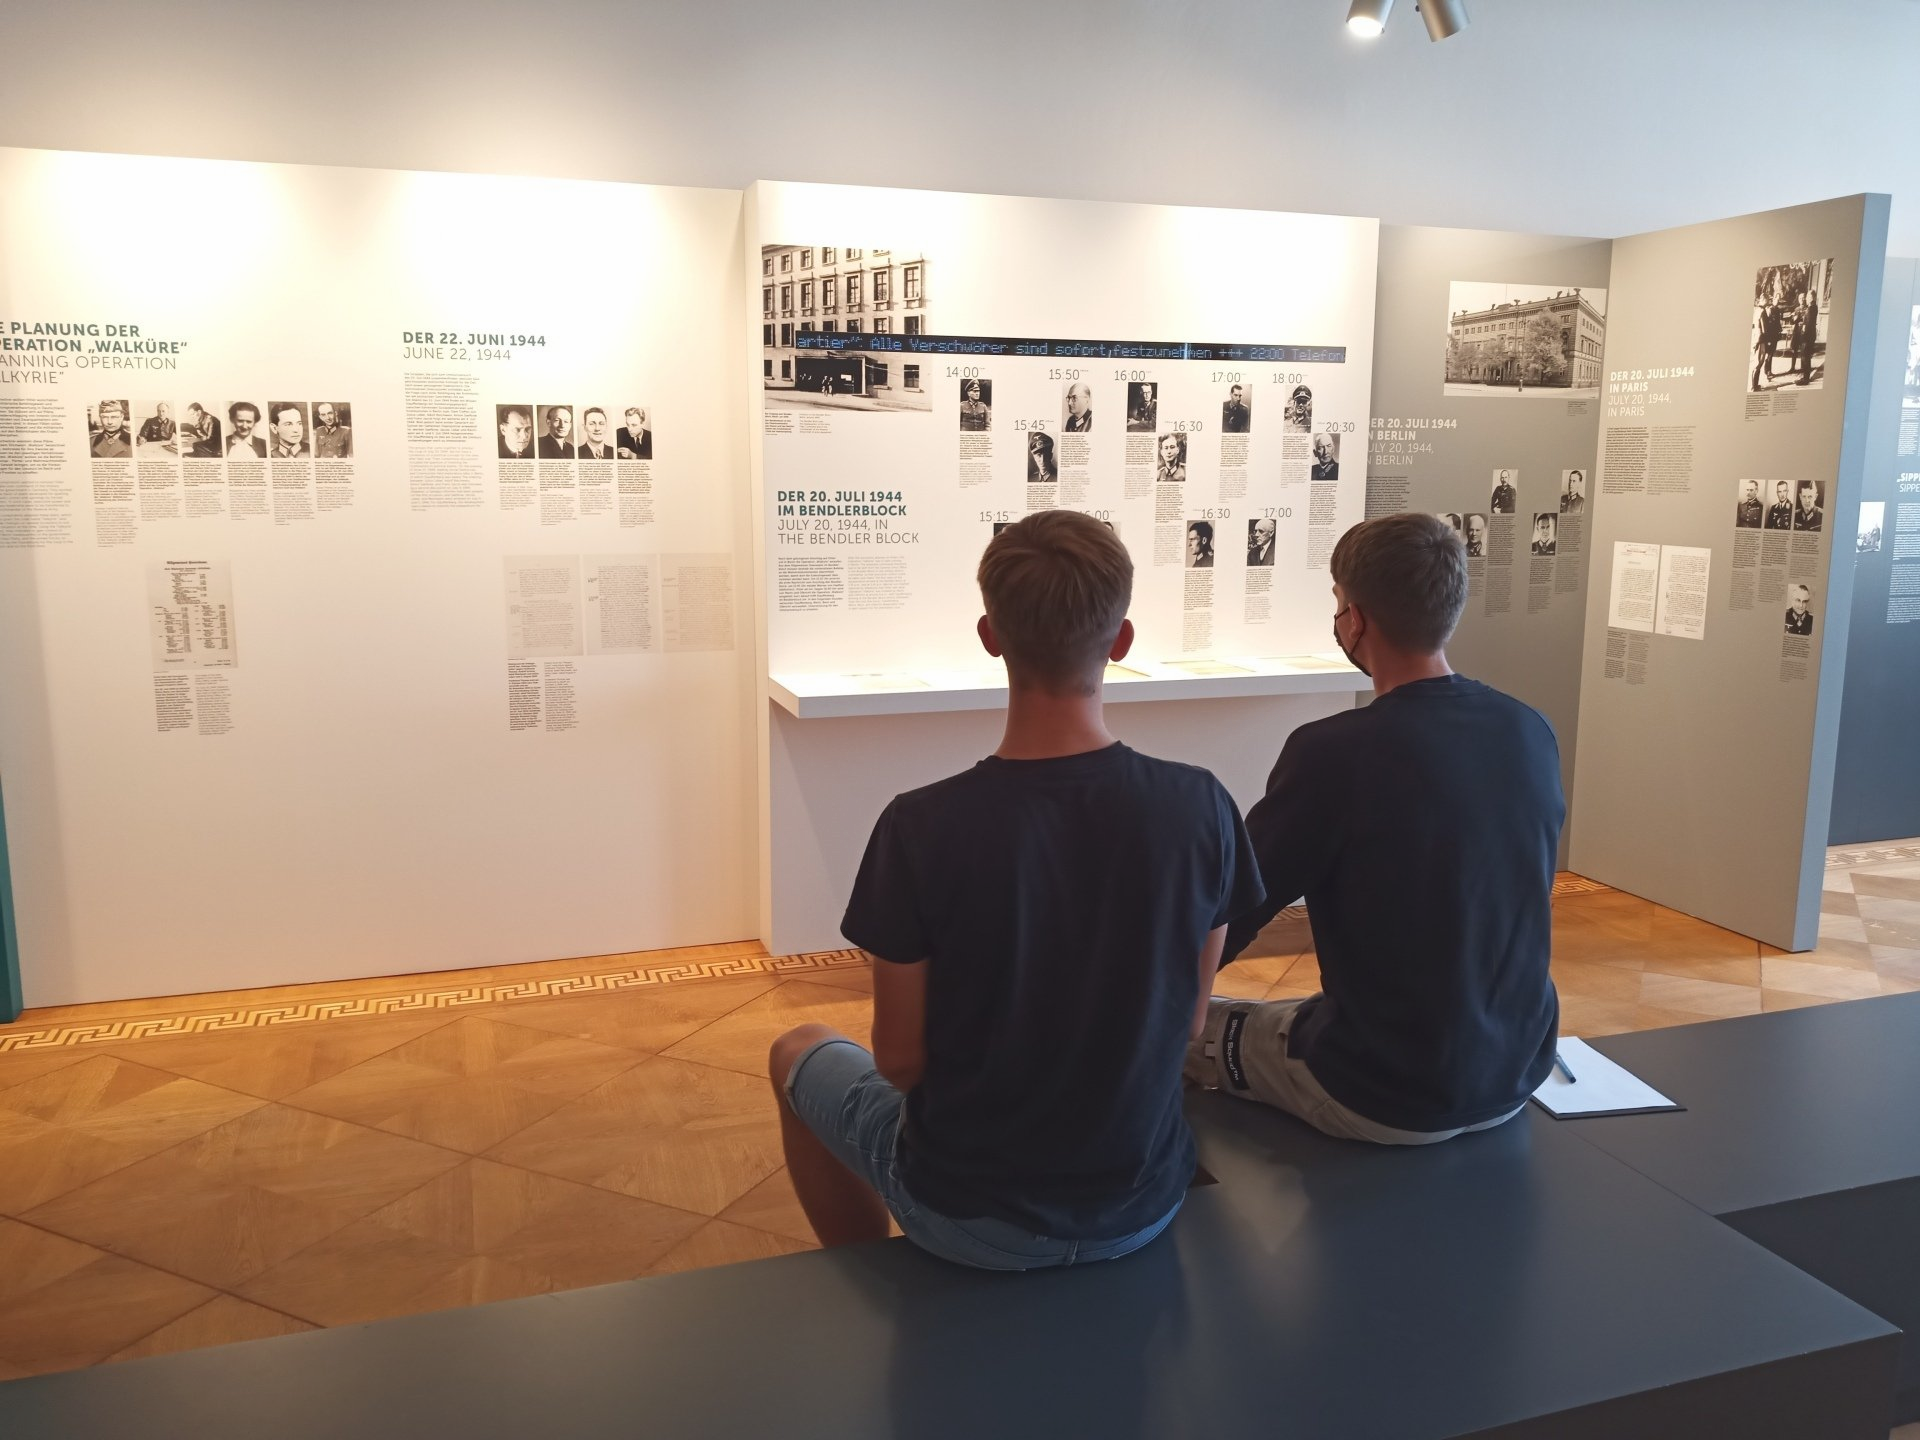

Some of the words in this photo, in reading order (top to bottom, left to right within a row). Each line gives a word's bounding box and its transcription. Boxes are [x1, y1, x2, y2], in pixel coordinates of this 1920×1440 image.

[11, 322, 100, 337] PLANUNG
[105, 324, 140, 337] DER
[0, 337, 82, 352] ERATION
[403, 332, 435, 344] DER
[439, 333, 463, 345] 22.
[467, 333, 505, 346] JUNI
[509, 334, 546, 346] 1944
[870, 337, 902, 350] Alle
[1015, 342, 1048, 355] sind
[403, 347, 444, 359] JUNE
[450, 348, 471, 361] 22,
[476, 348, 511, 361] 1944
[0, 354, 69, 369] ANNING
[75, 355, 176, 370] OPERATION
[0, 370, 64, 384] LKYRIE”
[946, 366, 980, 378] 14:00
[1049, 368, 1080, 380] 15:50
[1114, 370, 1146, 381] 16:00
[1211, 371, 1241, 383] 17:00
[1610, 371, 1629, 382] DER
[1630, 369, 1645, 381] 20.
[1647, 367, 1668, 379] JULI
[1670, 366, 1695, 378] 1944
[1272, 373, 1303, 384] 18:00
[1609, 383, 1619, 393] IN
[1621, 381, 1649, 393] PARIS
[1608, 394, 1630, 406] JULY
[1607, 407, 1617, 417] IN
[1619, 406, 1645, 417] PARIS
[1013, 419, 1045, 431] 15:45
[1173, 420, 1203, 432] 16:30
[1325, 421, 1355, 433] 20:30
[1371, 418, 1384, 428] ER
[1387, 418, 1403, 428] 20.
[1405, 418, 1429, 429] JULI
[1431, 418, 1457, 429] 1944
[1377, 430, 1416, 440] BERLIN
[1368, 442, 1386, 453] ULY
[1388, 442, 1404, 454] 20,
[1407, 442, 1434, 455] 1944,
[1375, 454, 1413, 465] BERLIN
[1896, 472, 1920, 483] „SIPP
[1899, 483, 1920, 493] SIPPE
[777, 490, 805, 502] DER
[810, 490, 831, 502] 20.
[835, 490, 865, 502] JULI
[869, 490, 902, 502] 1944
[778, 505, 794, 516] IM
[799, 504, 907, 516] BENDLERBLOCK
[1201, 508, 1231, 519] 16:30
[1264, 507, 1292, 518] 17:00
[979, 511, 1009, 522] 15:15
[777, 519, 809, 531] JULY
[814, 518, 833, 531] 20,
[837, 519, 871, 531] 1944,
[875, 519, 888, 530] IN
[777, 533, 805, 545] THE
[810, 532, 871, 544] BENDLER
[876, 532, 920, 544] BLOCK
